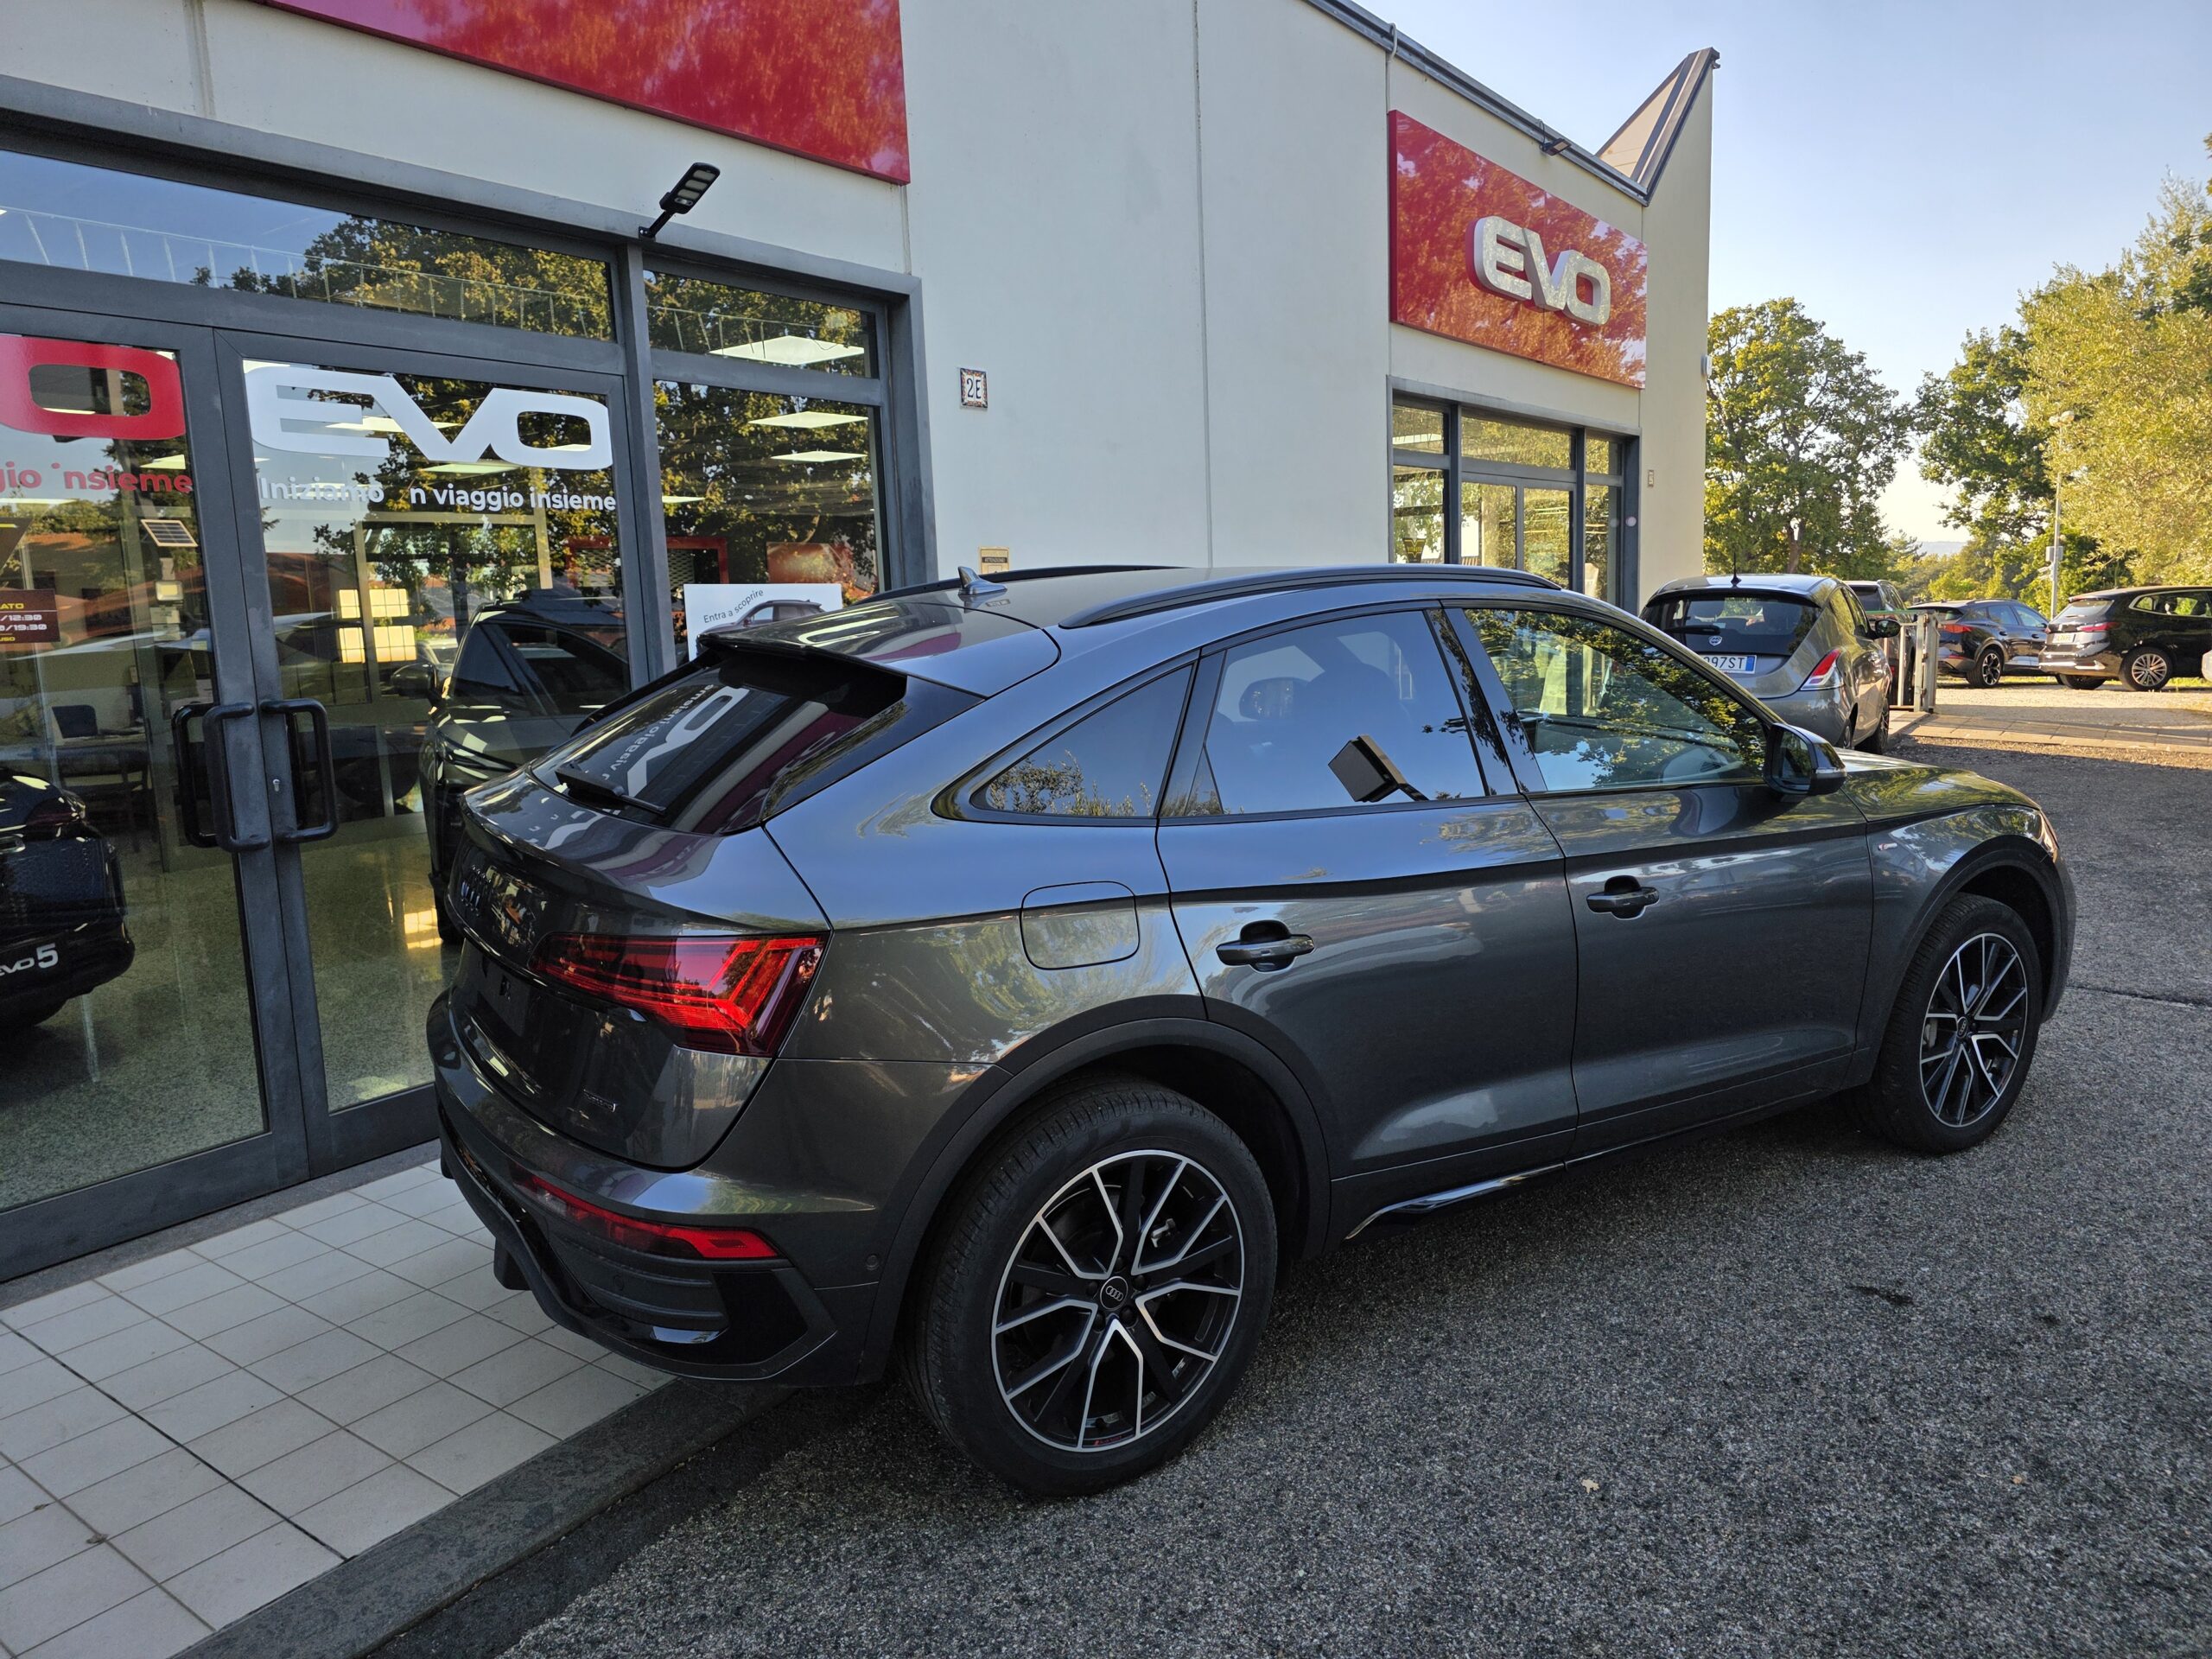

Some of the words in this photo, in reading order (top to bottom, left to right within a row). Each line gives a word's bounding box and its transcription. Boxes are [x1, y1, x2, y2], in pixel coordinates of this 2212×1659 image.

[1473, 215, 1611, 325] EVO
[966, 378, 982, 399] 2E
[244, 365, 613, 471] EVO
[0, 461, 42, 493] io
[51, 462, 194, 494] nsieme
[260, 476, 385, 503] Iniziamo
[433, 483, 524, 512] viaggio
[529, 486, 616, 512] insieme
[703, 611, 727, 624] Entra
[734, 588, 764, 613] scoprire
[1703, 657, 1745, 670] 97ST
